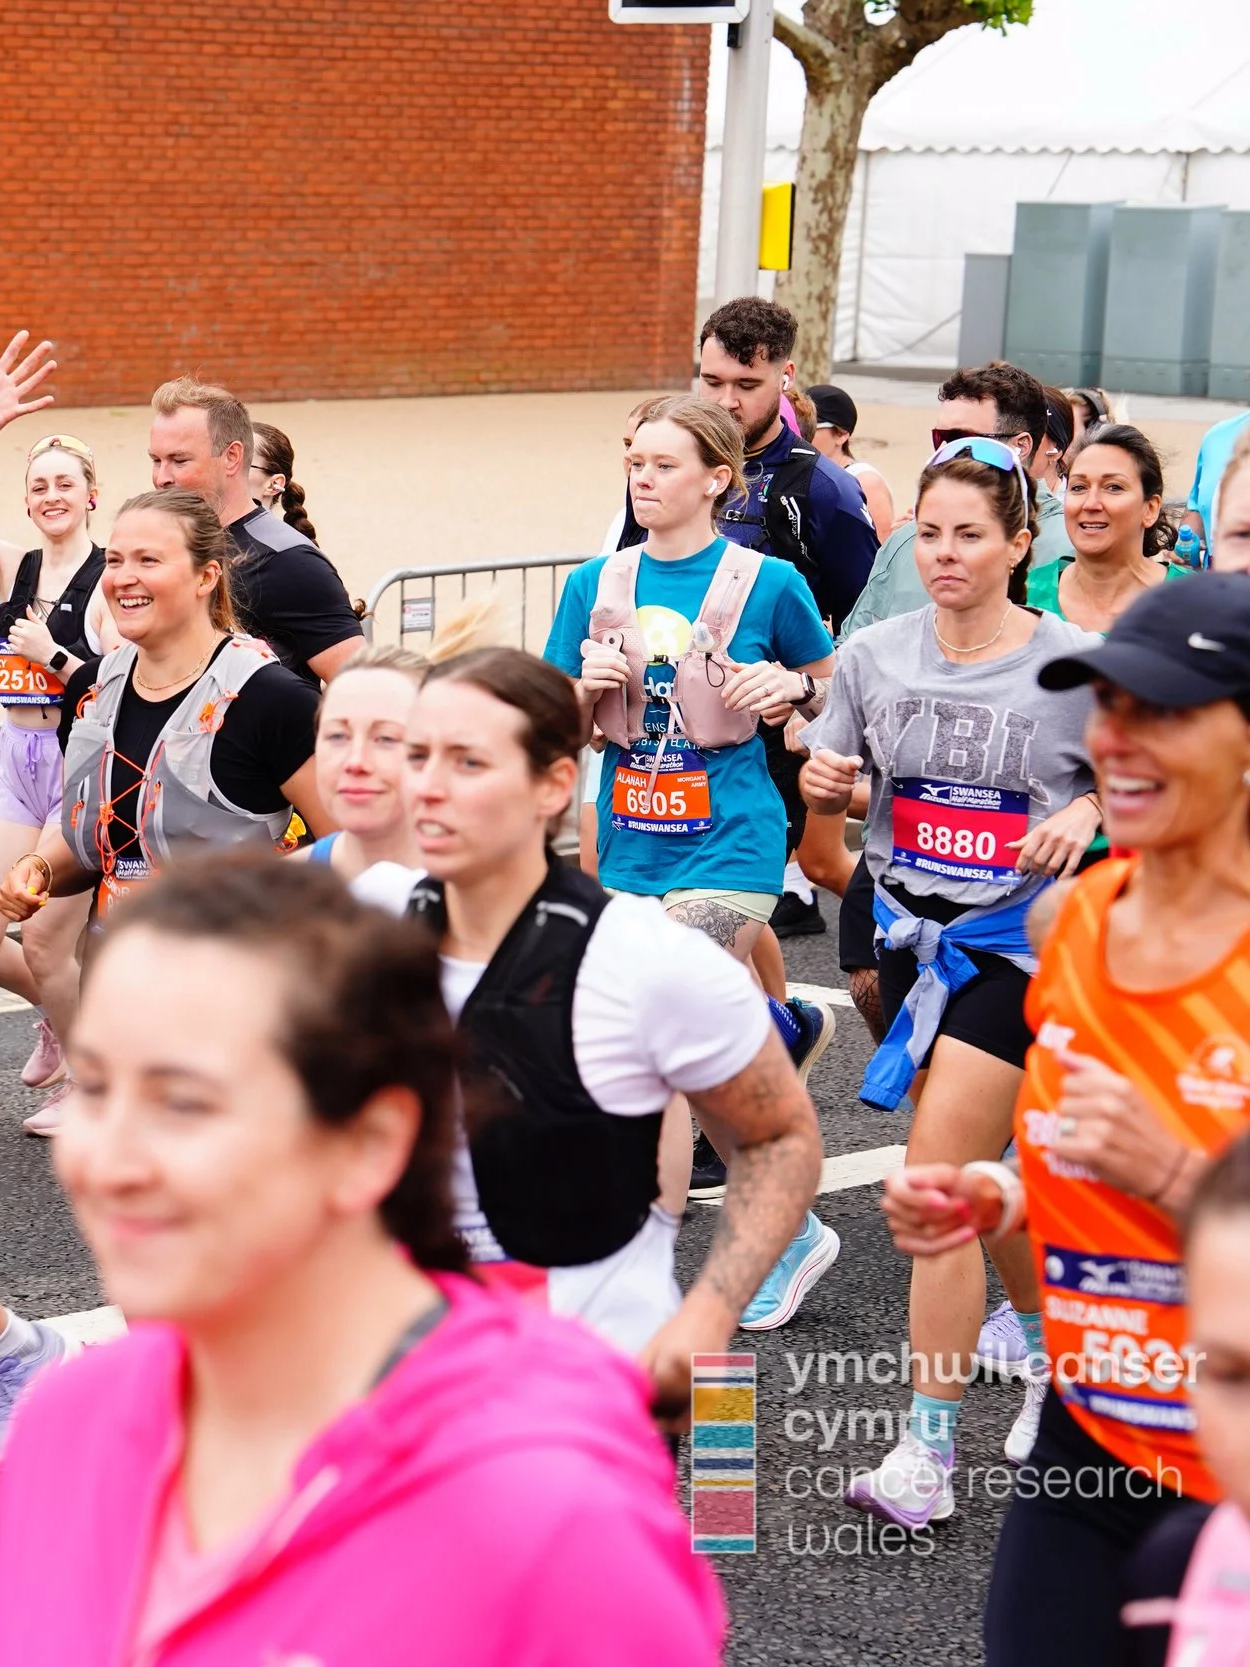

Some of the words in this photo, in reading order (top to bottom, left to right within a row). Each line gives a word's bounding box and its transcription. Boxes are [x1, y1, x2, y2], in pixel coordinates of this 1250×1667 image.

[0, 669, 48, 691] 2510
[616, 772, 647, 787] ALANAH
[626, 788, 687, 816] 6905
[952, 786, 1001, 799] SWANSEA
[628, 820, 688, 833] #RUNSWANSEA
[917, 822, 996, 860] 8880
[915, 858, 994, 880] #RUNSWANSEA
[1045, 1295, 1149, 1336] SUZANNE
